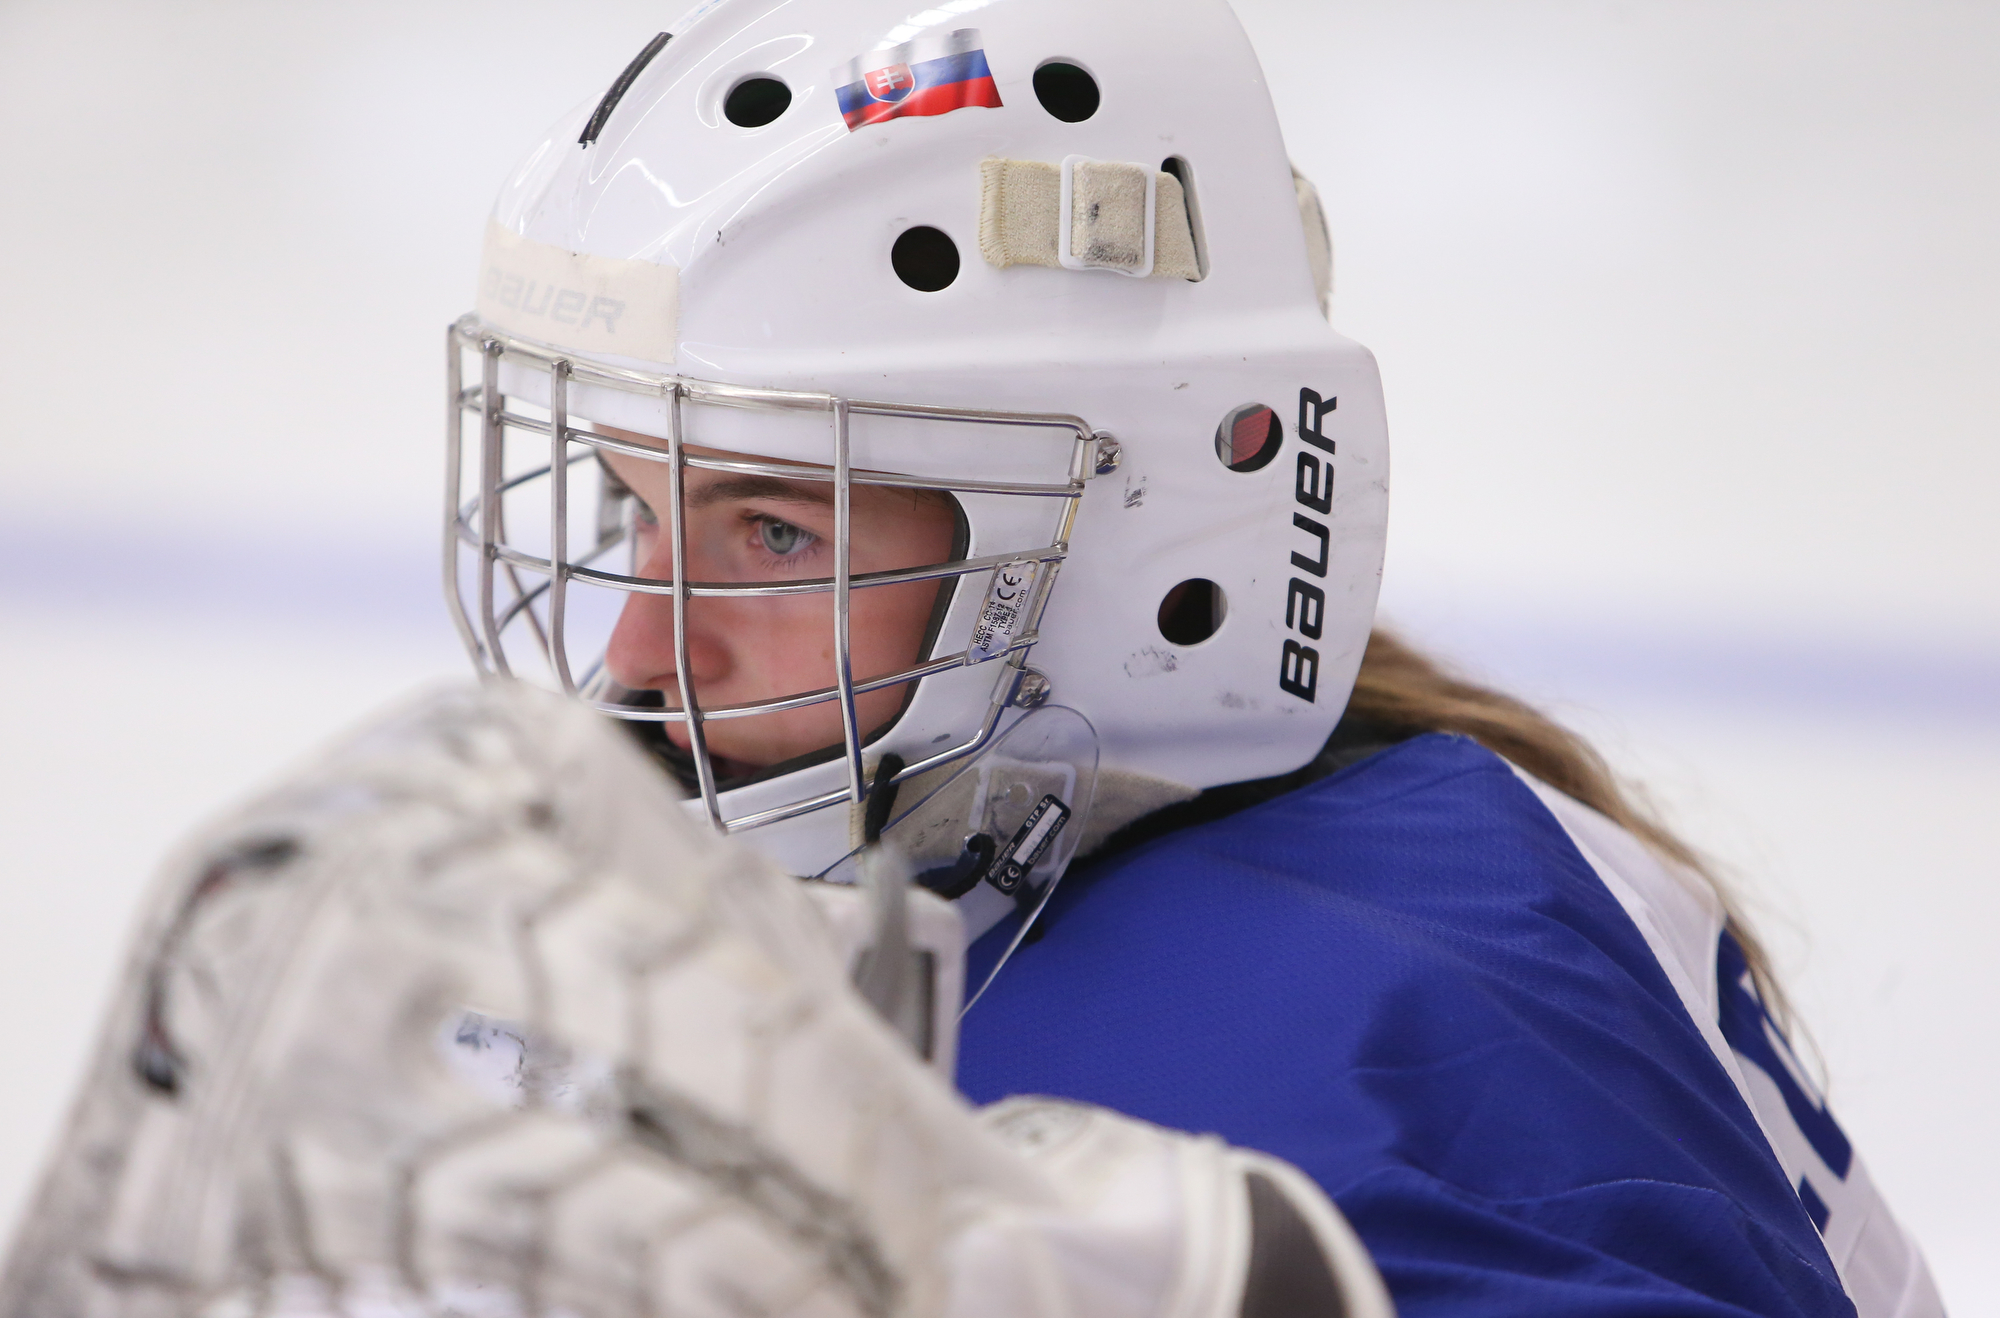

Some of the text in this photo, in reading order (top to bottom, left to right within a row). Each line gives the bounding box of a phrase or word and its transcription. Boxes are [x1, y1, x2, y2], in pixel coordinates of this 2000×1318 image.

[998, 612, 1011, 629] TYPE
[1003, 589, 1026, 635] bauer.com
[974, 625, 987, 644] HECC
[980, 633, 994, 652] ASTM
[1025, 809, 1041, 828] GTP
